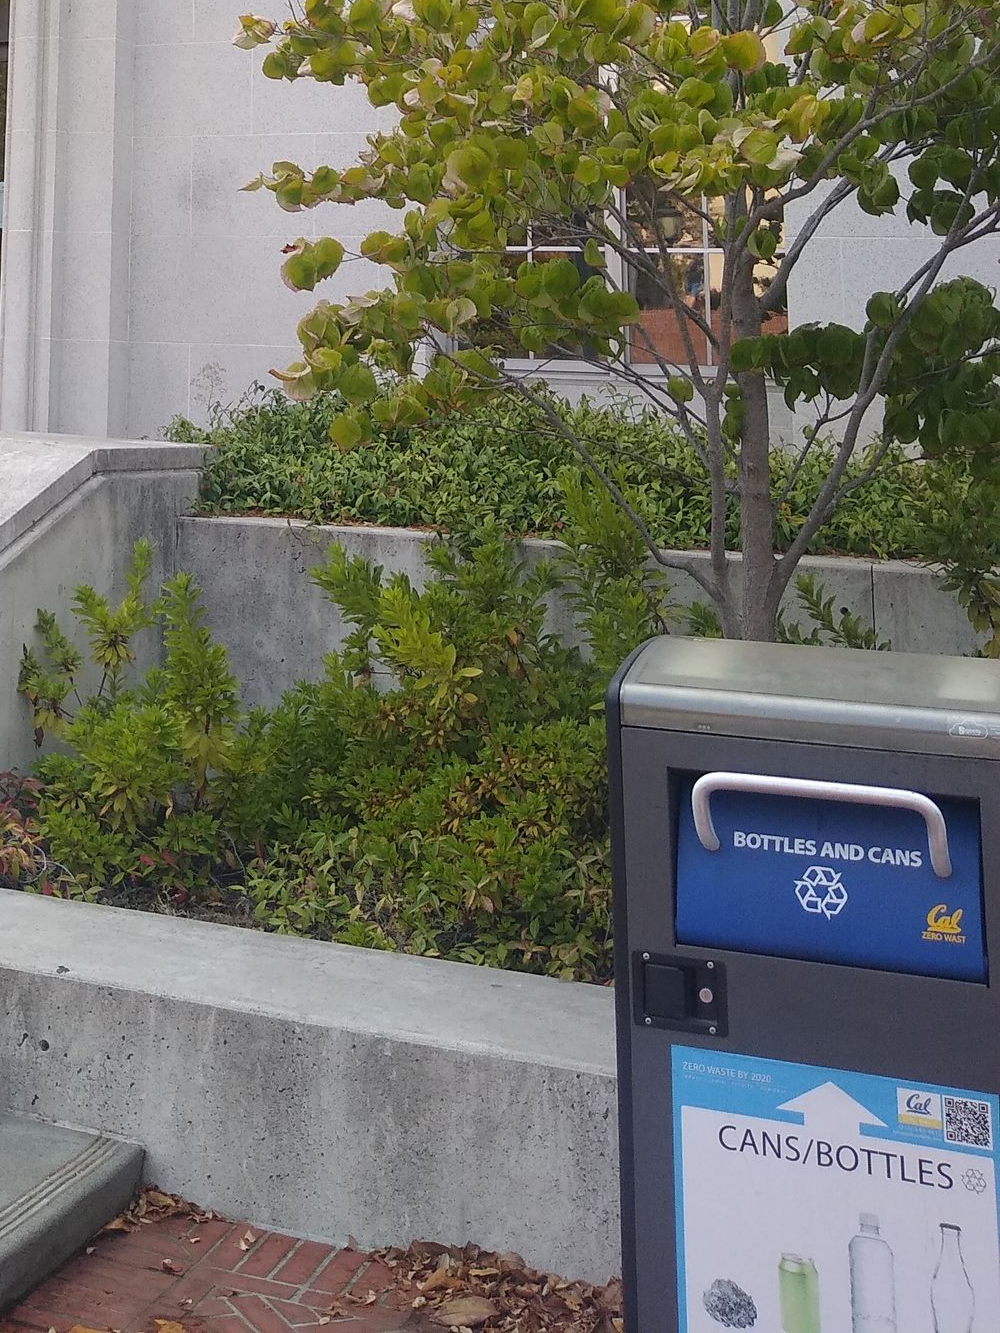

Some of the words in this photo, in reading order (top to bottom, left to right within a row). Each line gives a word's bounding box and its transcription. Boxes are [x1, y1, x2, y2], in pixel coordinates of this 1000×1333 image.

[733, 831, 817, 856] BOTTLES
[820, 841, 865, 861] AND
[867, 847, 923, 868] CANS
[927, 904, 963, 934] Cal
[921, 931, 943, 941] ZERO
[682, 1061, 706, 1073] ZERO
[706, 1066, 736, 1078] WASTE
[737, 1070, 749, 1080] BY
[751, 1072, 772, 1083] 2020
[905, 1093, 932, 1116] Cal
[718, 1124, 955, 1190] CANS/BOTTLES
